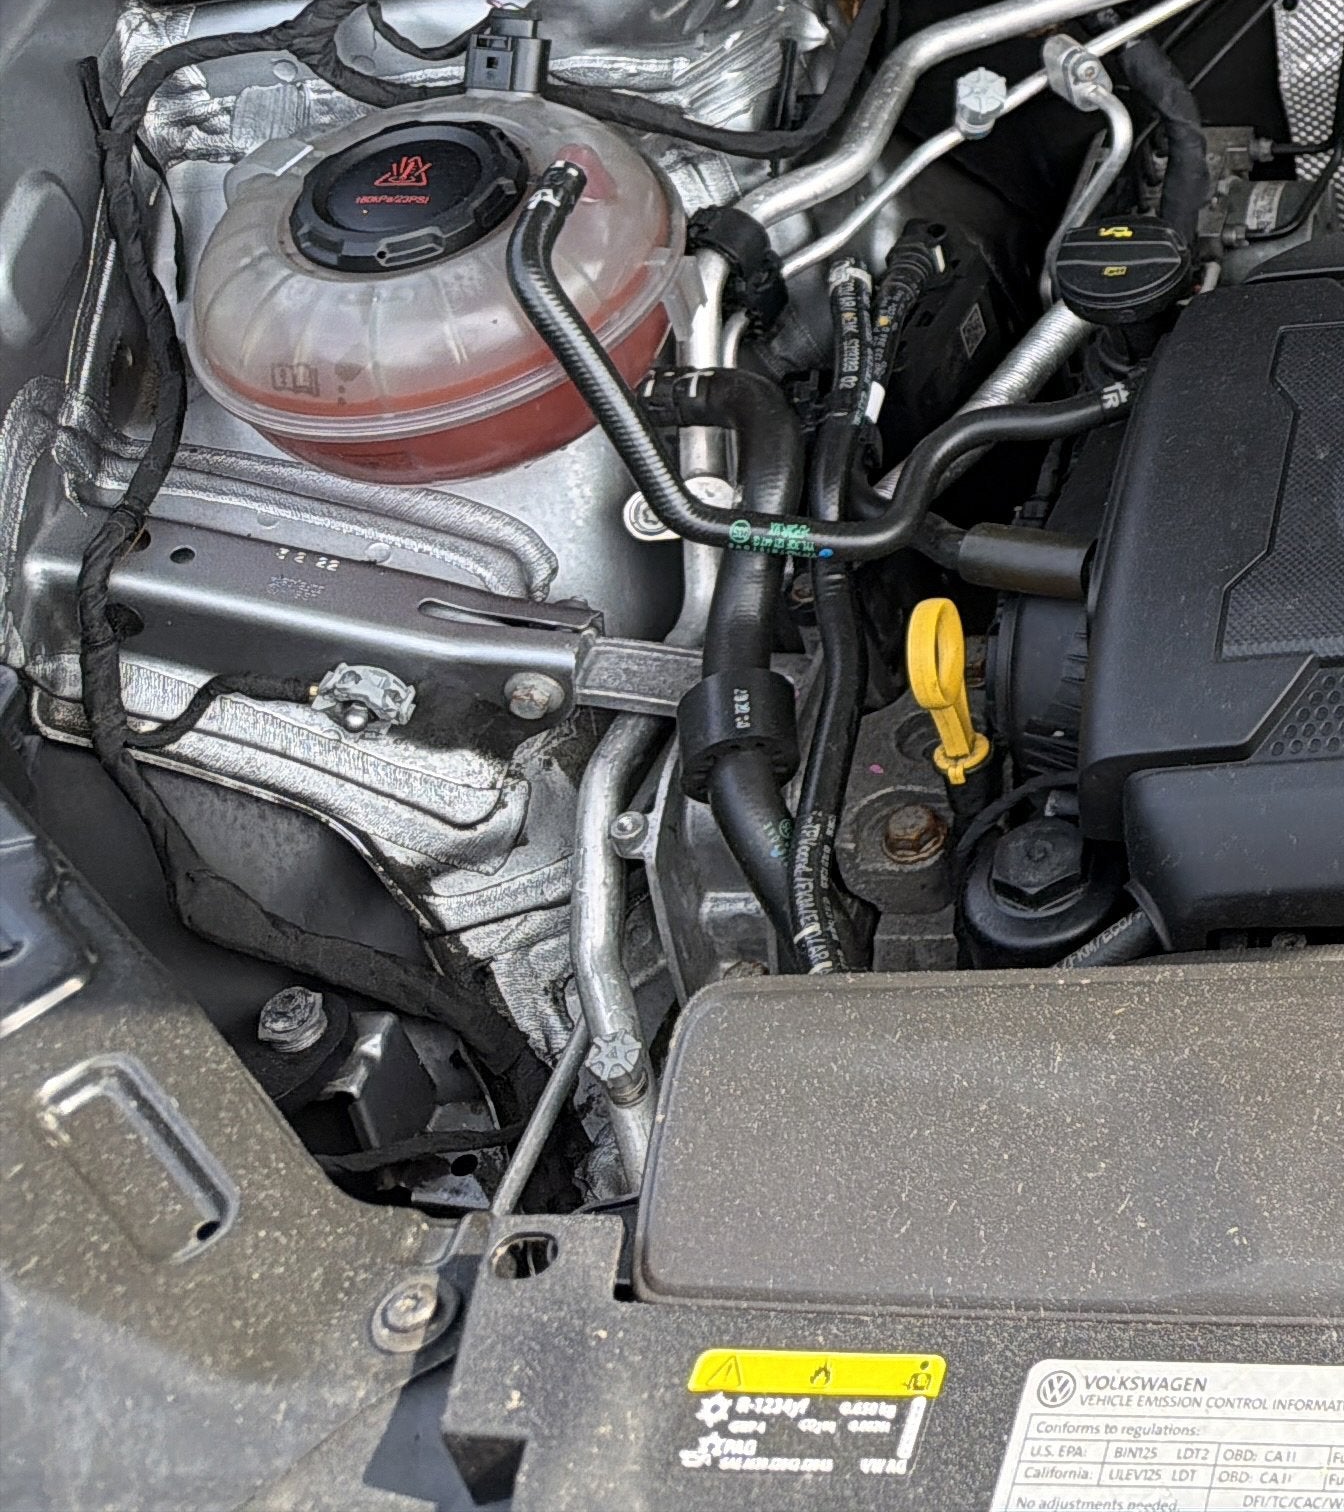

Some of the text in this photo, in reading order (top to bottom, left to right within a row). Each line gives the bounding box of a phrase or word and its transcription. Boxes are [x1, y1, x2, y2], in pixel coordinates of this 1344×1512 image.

[1085, 1375, 1207, 1392] VOLKSWAGEN
[1079, 1394, 1133, 1407] VEHICLE
[1136, 1395, 1202, 1408] EMISSION
[1205, 1396, 1269, 1410] CONTROL
[1036, 1421, 1200, 1438] Conforms to regulations:
[1030, 1445, 1087, 1458] U.S. EPA:
[1114, 1446, 1210, 1461] BIN125 LDT2
[1222, 1449, 1257, 1462] OBD:
[1264, 1450, 1284, 1462] CA
[1024, 1466, 1093, 1480] California:
[1108, 1468, 1197, 1481] ULEV125 LDT
[1218, 1471, 1253, 1483] OBD:
[1259, 1472, 1280, 1484] CA
[1016, 1496, 1036, 1509] No
[1039, 1496, 1123, 1512] adjustments
